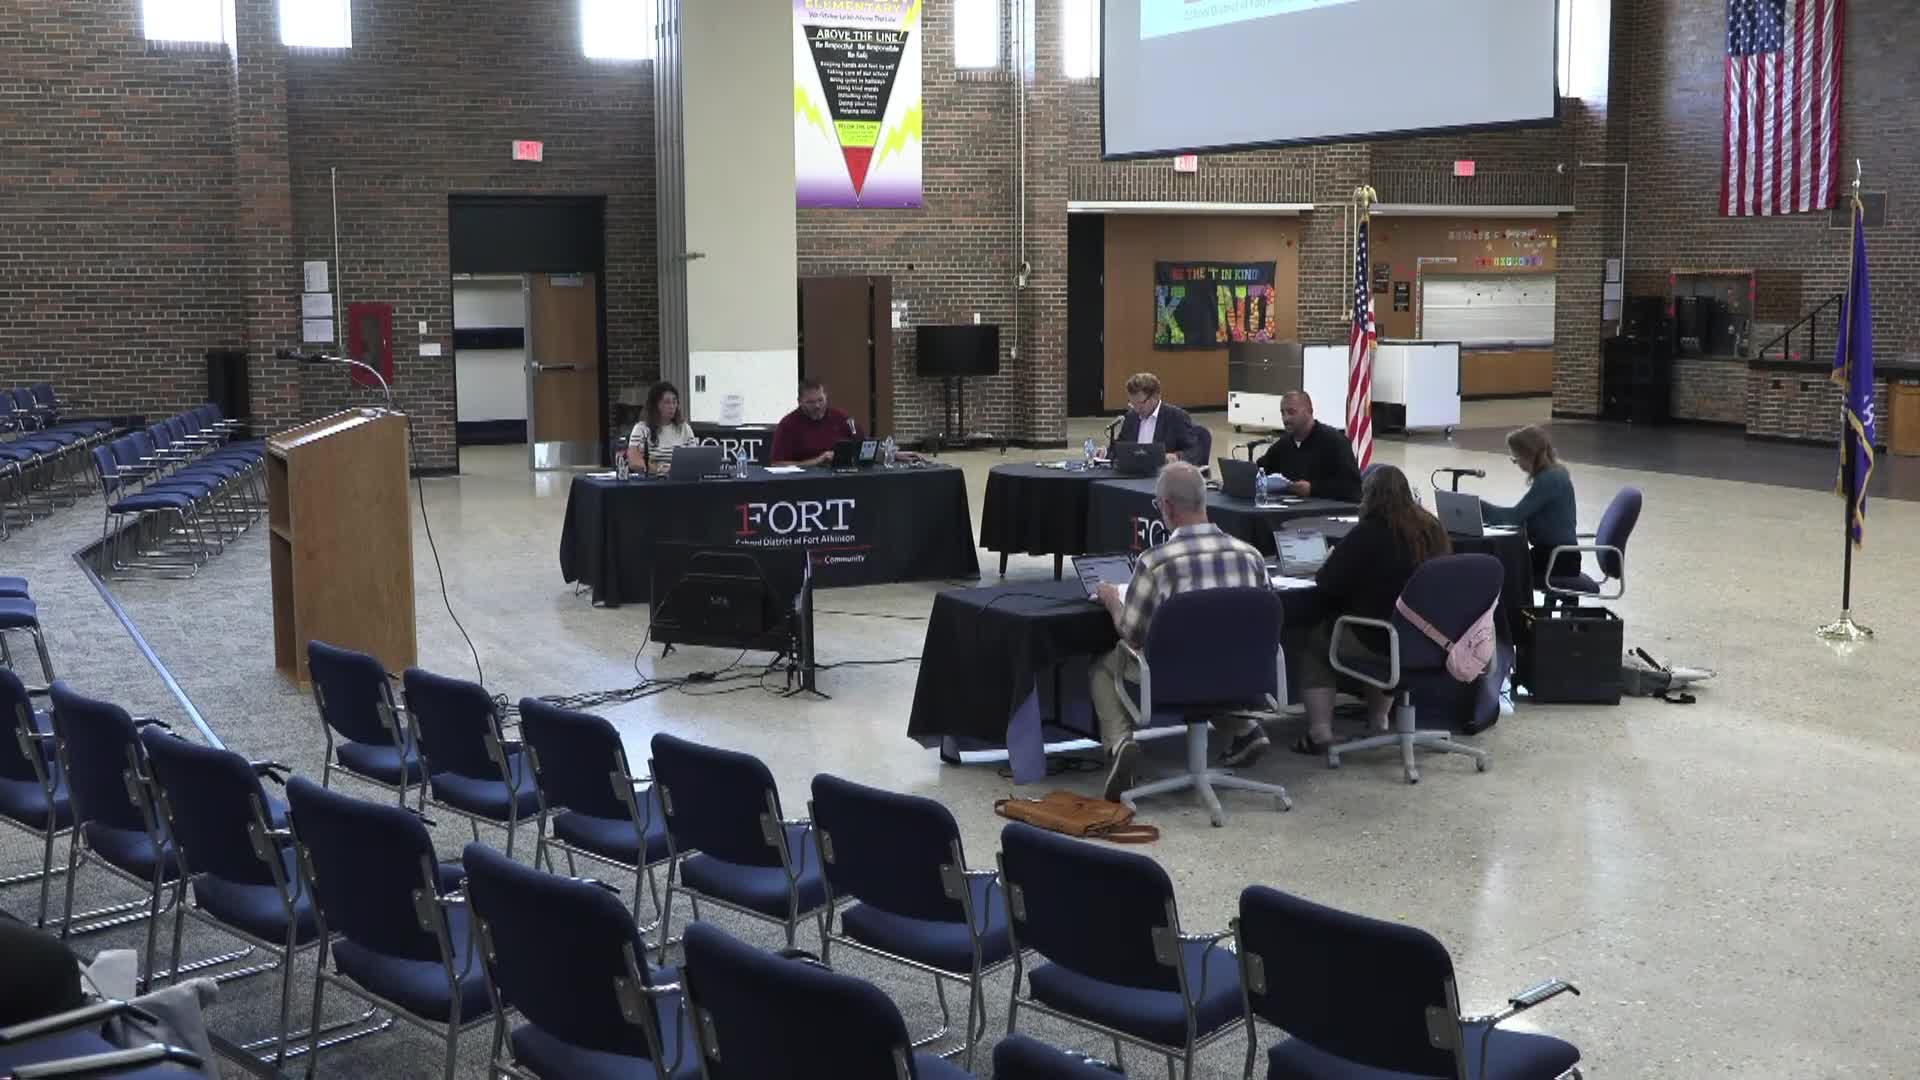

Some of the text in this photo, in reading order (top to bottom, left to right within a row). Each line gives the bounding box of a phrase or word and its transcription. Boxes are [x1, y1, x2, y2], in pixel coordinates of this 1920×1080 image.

[805, 0, 901, 13] ELEMENTARY
[816, 29, 897, 42] ABOVE THE LINE
[824, 42, 854, 51] Respectful
[866, 44, 899, 53] Responsible
[1221, 268, 1232, 280] IN
[1234, 268, 1259, 280] KIND
[763, 537, 793, 547] District
[803, 536, 820, 545] Fort
[821, 535, 856, 543] Atkinson
[824, 555, 865, 564] Community
